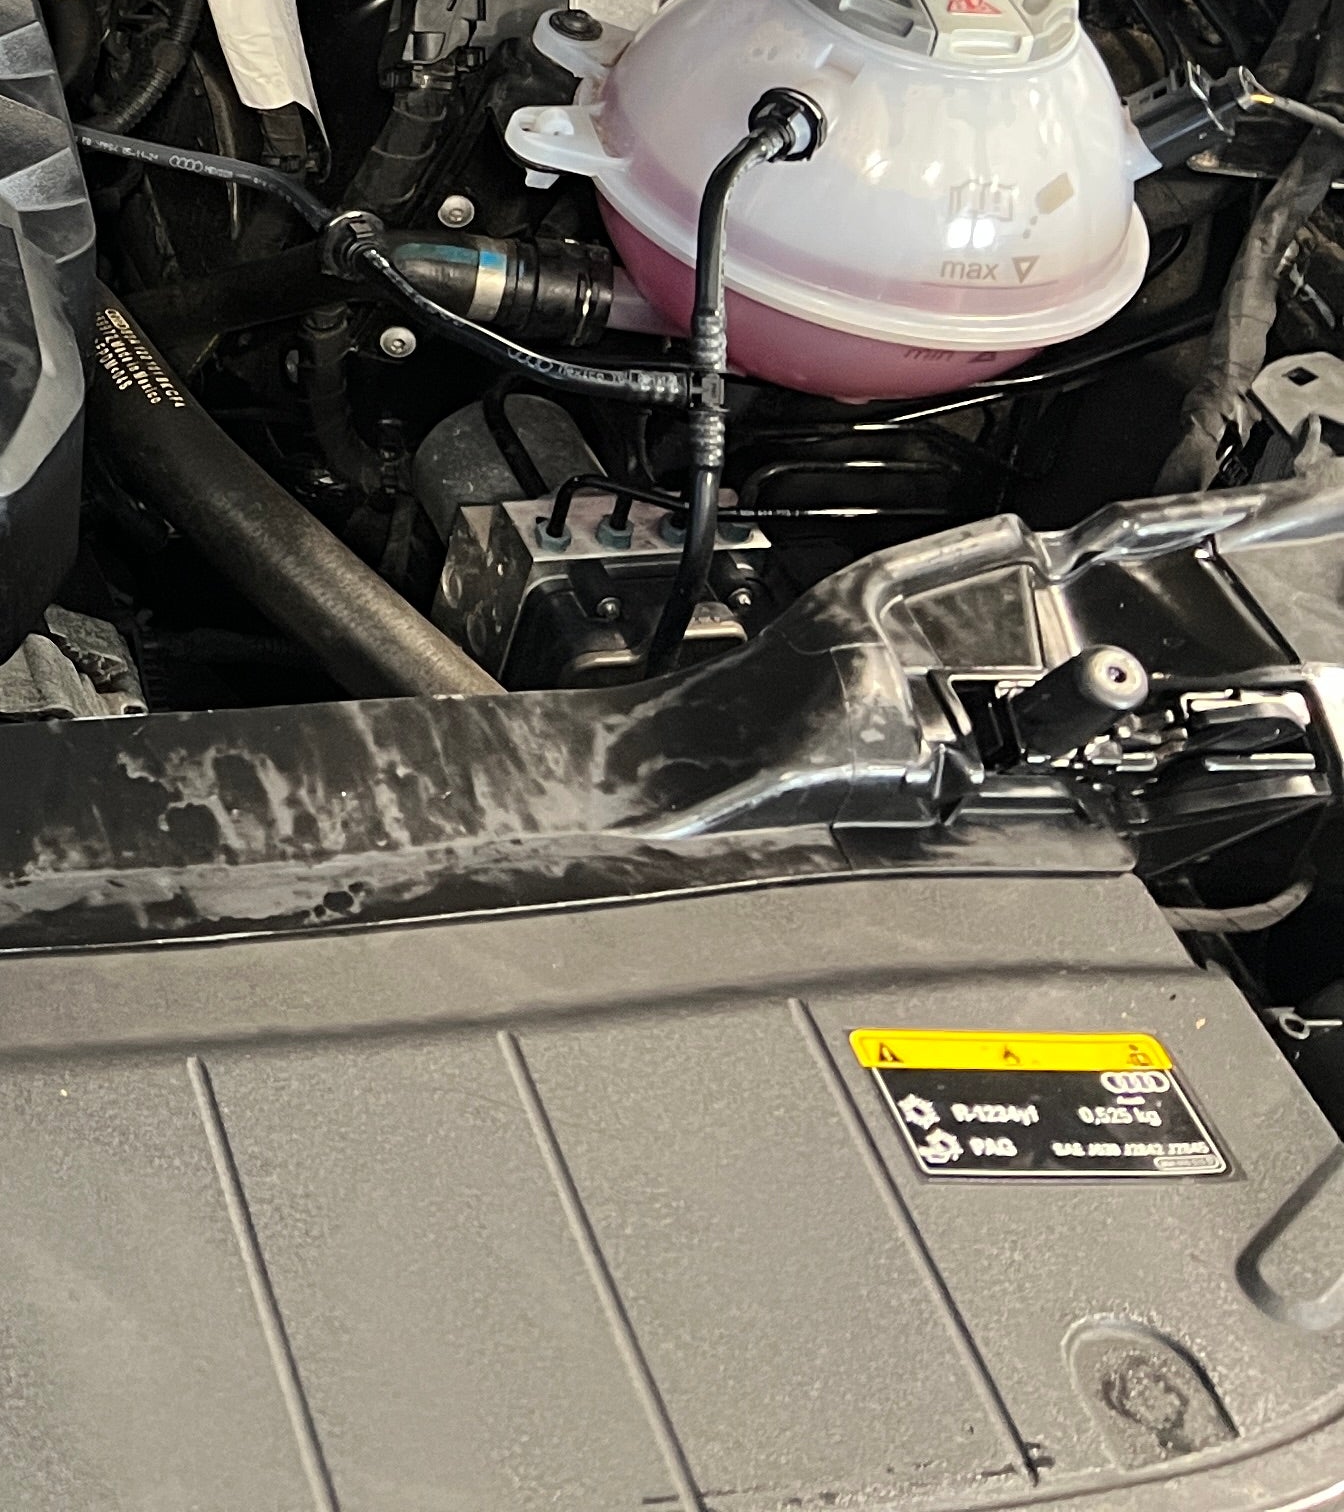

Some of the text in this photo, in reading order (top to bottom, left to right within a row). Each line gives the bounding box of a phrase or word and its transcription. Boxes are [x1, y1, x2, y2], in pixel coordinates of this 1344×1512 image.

[940, 260, 999, 281] max
[1077, 1106, 1133, 1126] 0,525
[1133, 1107, 1162, 1127] kg
